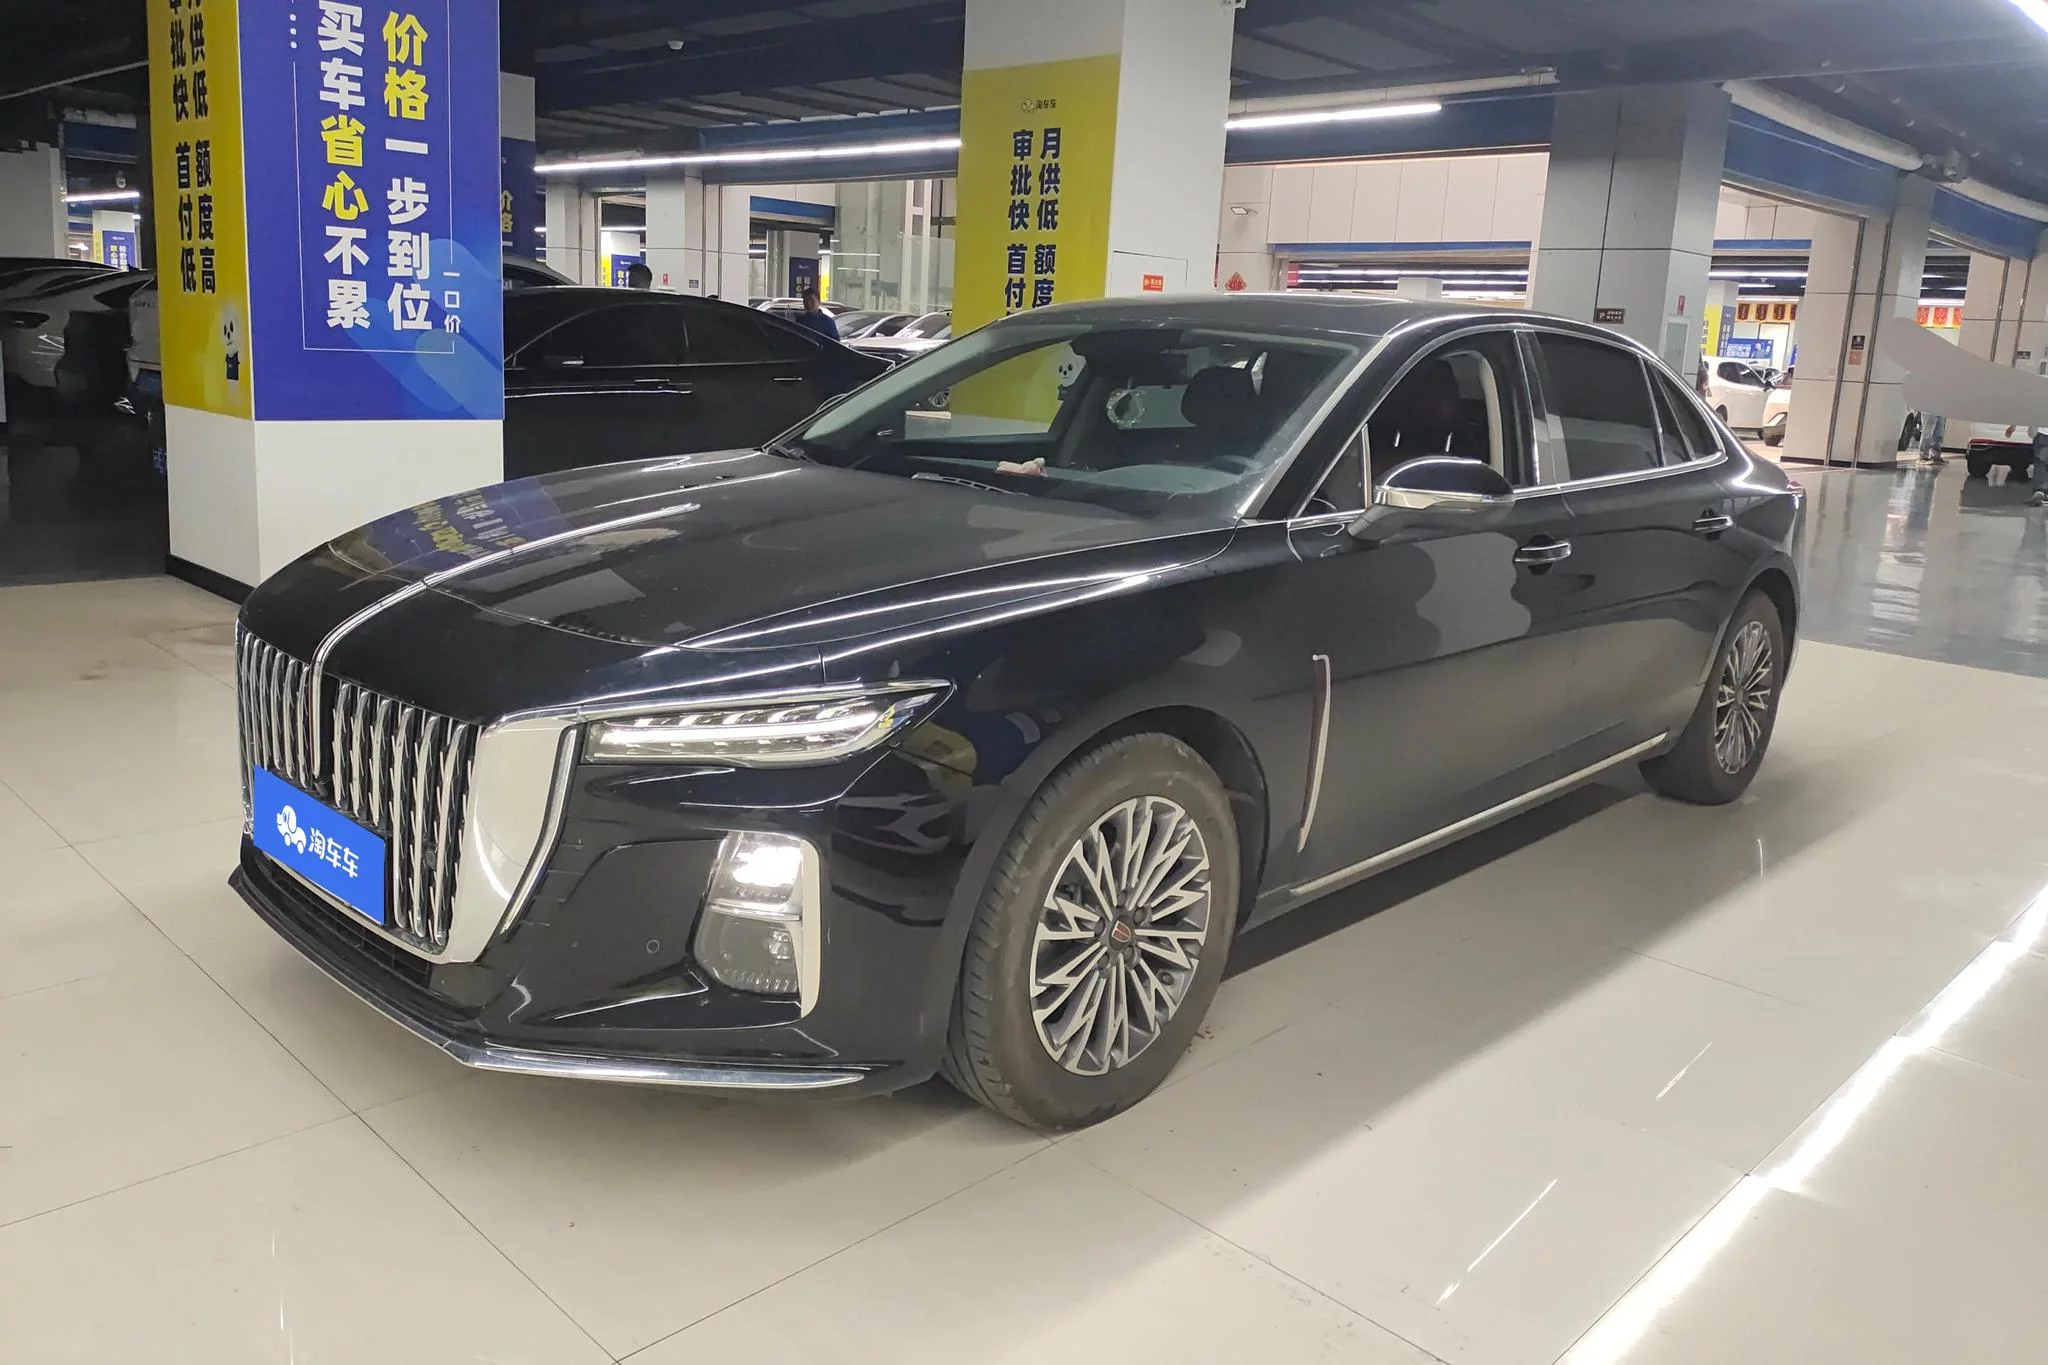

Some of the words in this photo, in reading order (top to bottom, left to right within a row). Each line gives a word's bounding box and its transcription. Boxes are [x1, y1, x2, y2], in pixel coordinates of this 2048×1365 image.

[188, 0, 208, 119] 供低
[175, 141, 196, 292] 首付低
[195, 140, 216, 294] 额度高
[318, 0, 371, 328] 买车省心不累
[383, 11, 432, 331] 价格一步到位
[1008, 129, 1033, 231] 审批快
[1037, 127, 1061, 231] 月供低
[443, 272, 461, 334] 一口价
[1005, 243, 1028, 316] 首付
